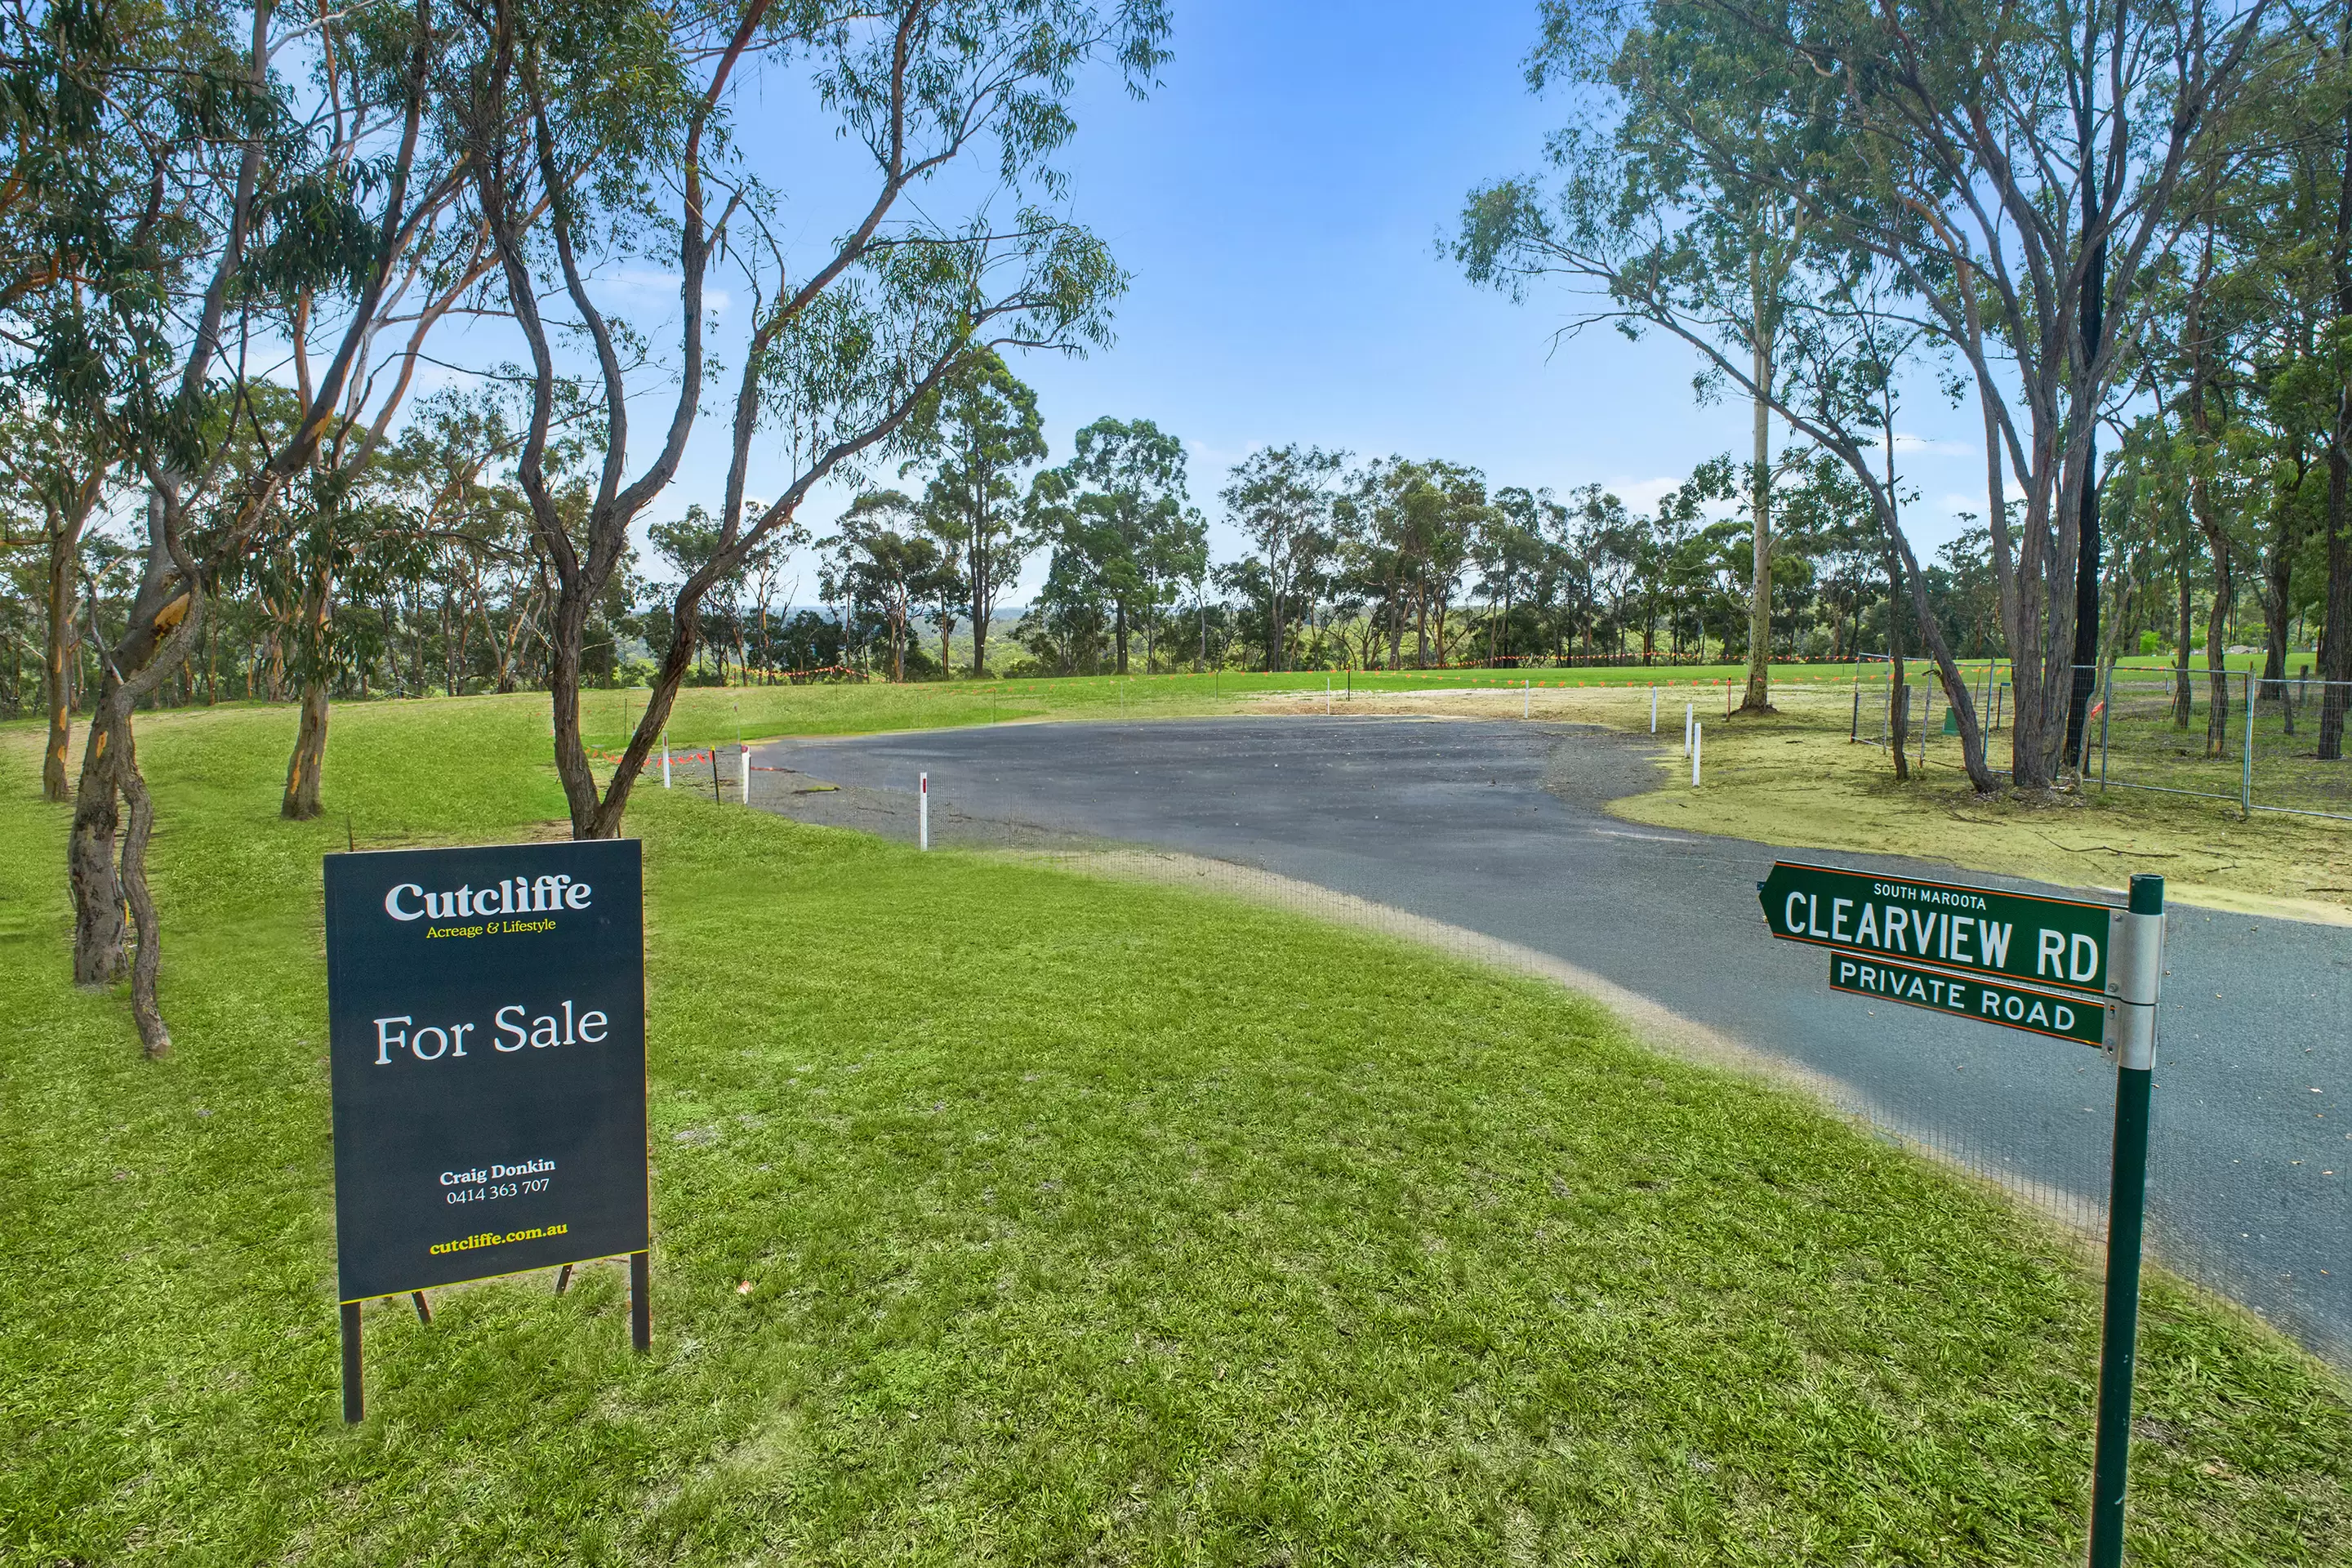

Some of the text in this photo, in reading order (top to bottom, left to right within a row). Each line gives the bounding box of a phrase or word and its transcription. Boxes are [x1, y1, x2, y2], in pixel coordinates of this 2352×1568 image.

[385, 874, 592, 921] Cutcliffe
[1873, 883, 1987, 911] SOUTH MAROOTA
[425, 918, 556, 938] Acreage & Lifestyle
[1785, 891, 2099, 983] CLEARVIEW RD
[1839, 961, 2076, 1031] PRIVATE ROAD
[372, 1000, 608, 1065] For Sale
[439, 1158, 556, 1187] Craig Donkin
[447, 1178, 550, 1205] 0414 363 707
[430, 1222, 568, 1255] cutcliffe.com.au
